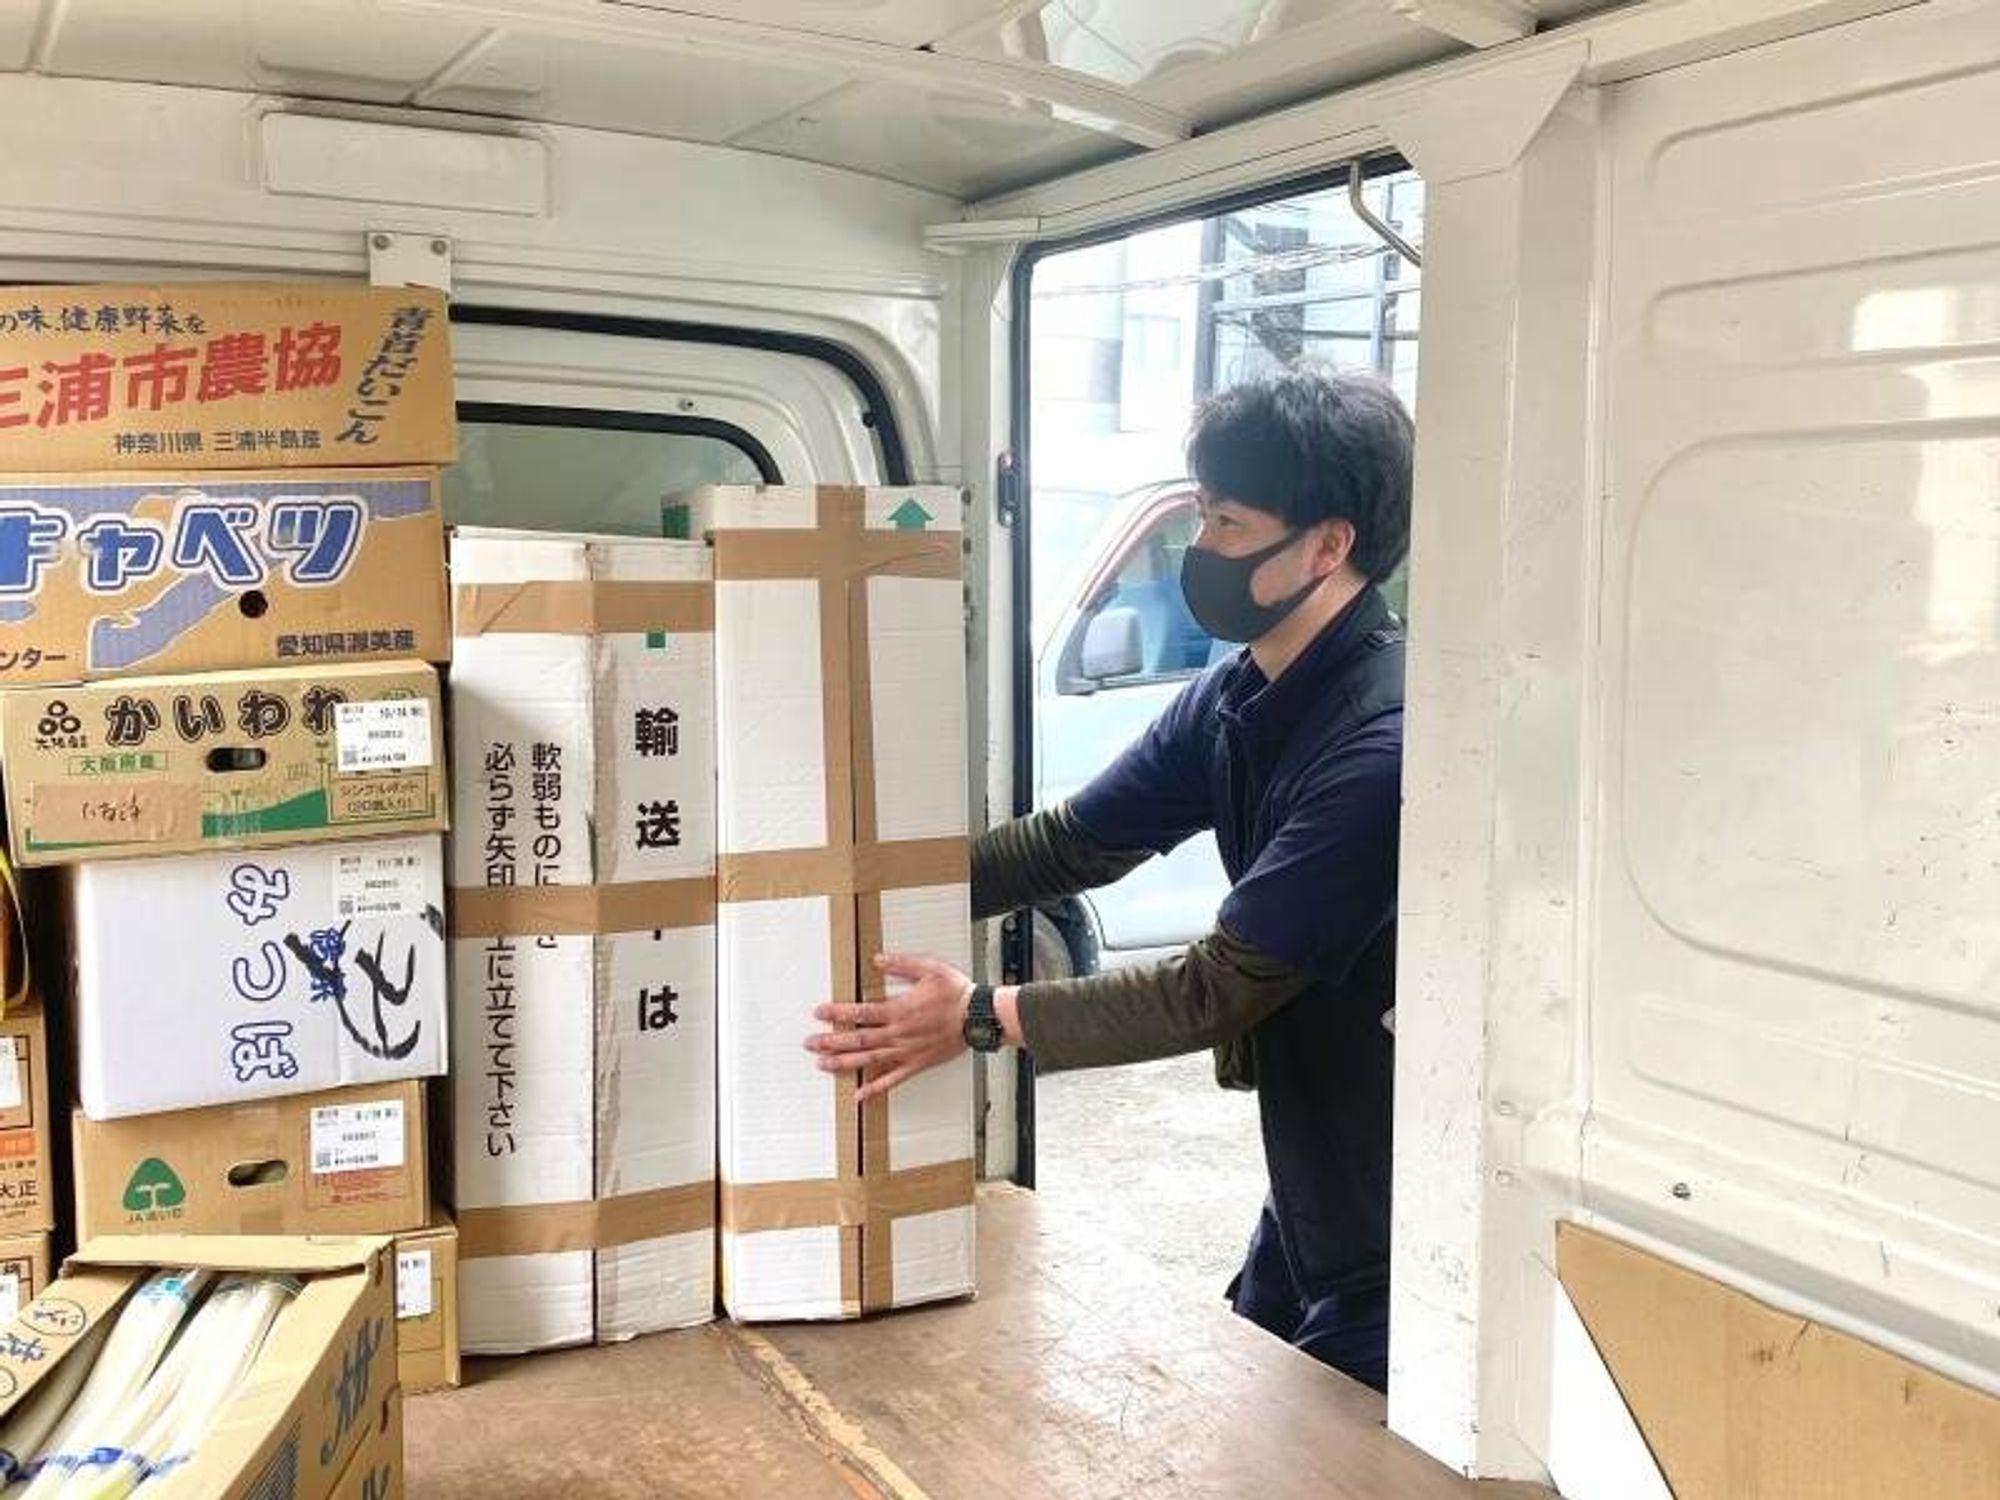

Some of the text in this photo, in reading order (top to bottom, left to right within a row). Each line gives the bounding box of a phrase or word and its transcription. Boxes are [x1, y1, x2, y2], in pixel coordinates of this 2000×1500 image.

[115, 429, 321, 454] 神奈川県 三浦半島産
[531, 742, 562, 950] 軟弱ものに
[635, 707, 681, 1032] 輸送は
